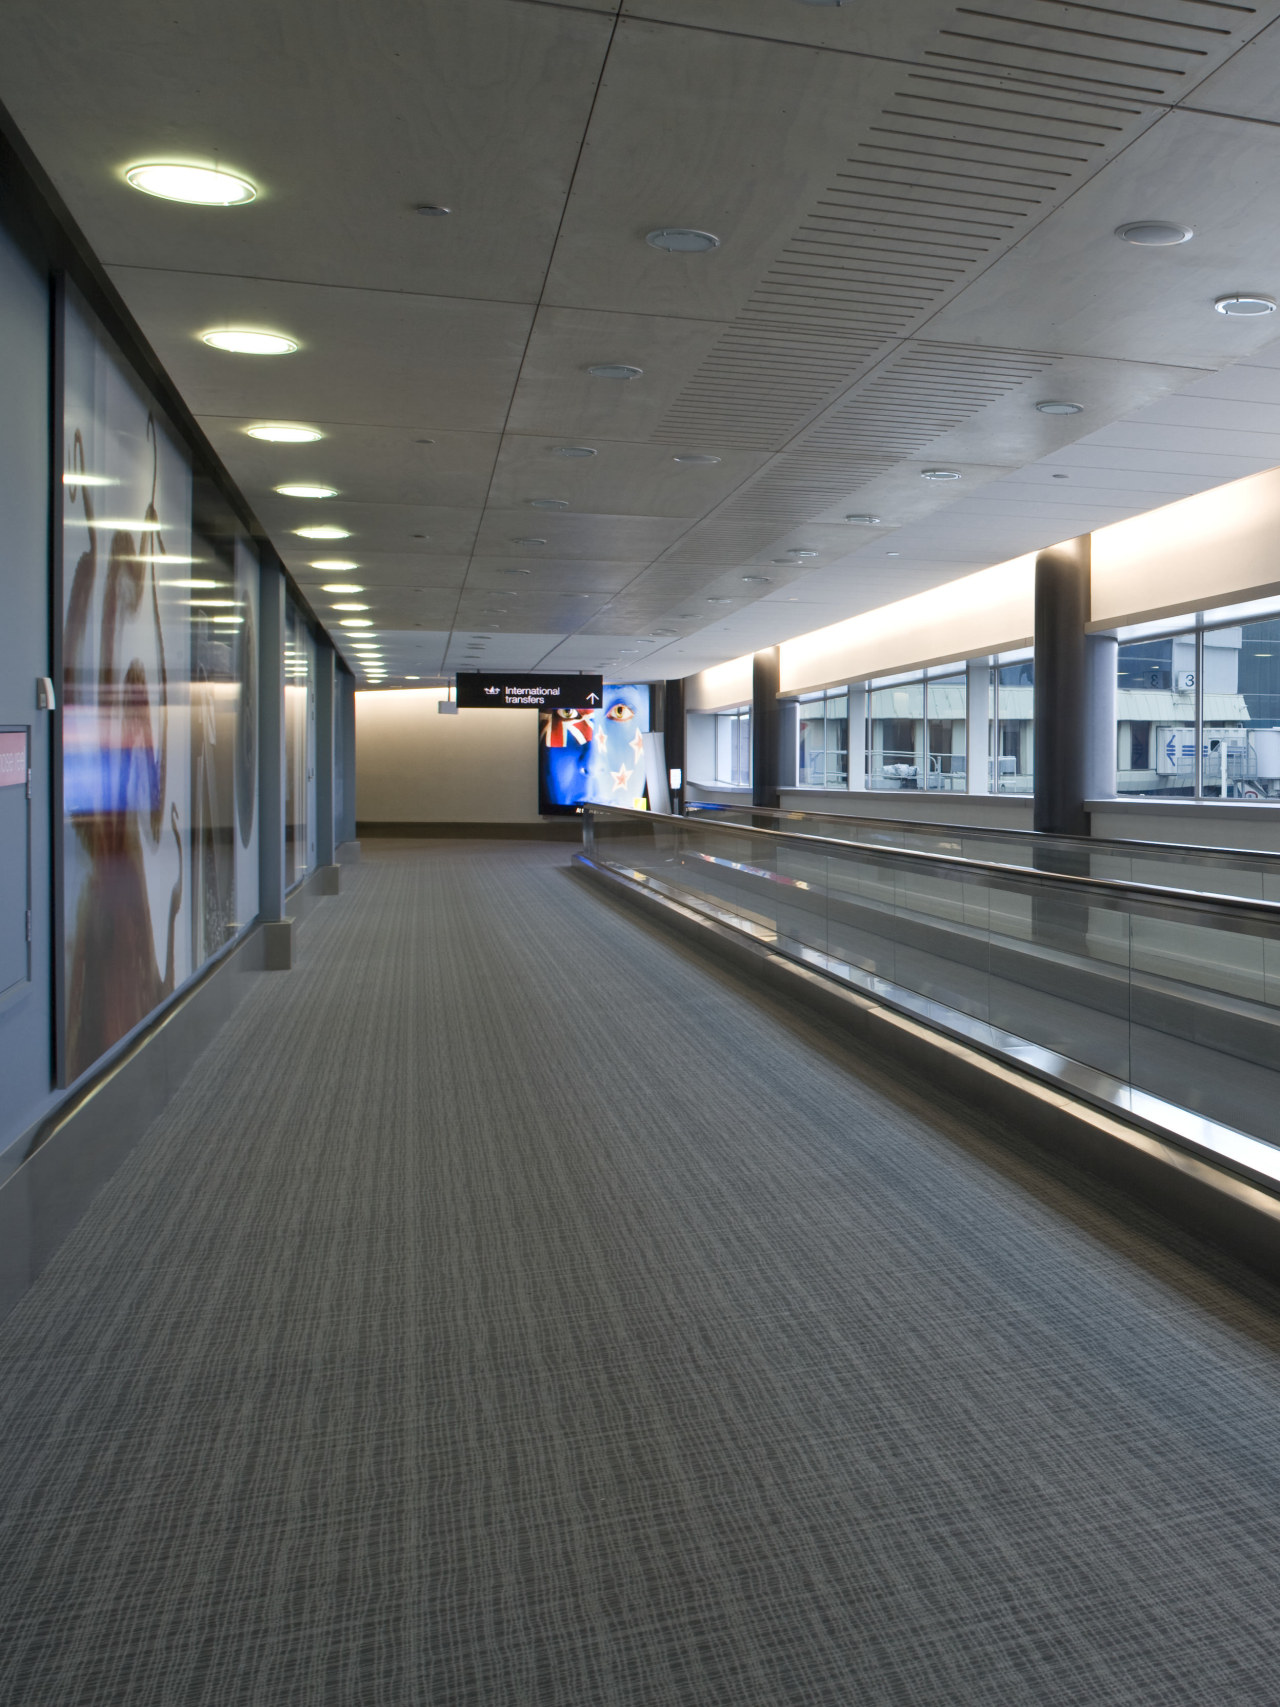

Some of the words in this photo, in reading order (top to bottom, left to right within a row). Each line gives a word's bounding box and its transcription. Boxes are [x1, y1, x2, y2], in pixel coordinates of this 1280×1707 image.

[1185, 674, 1195, 687] 3
[505, 686, 560, 696] International
[505, 695, 545, 704] transfers
